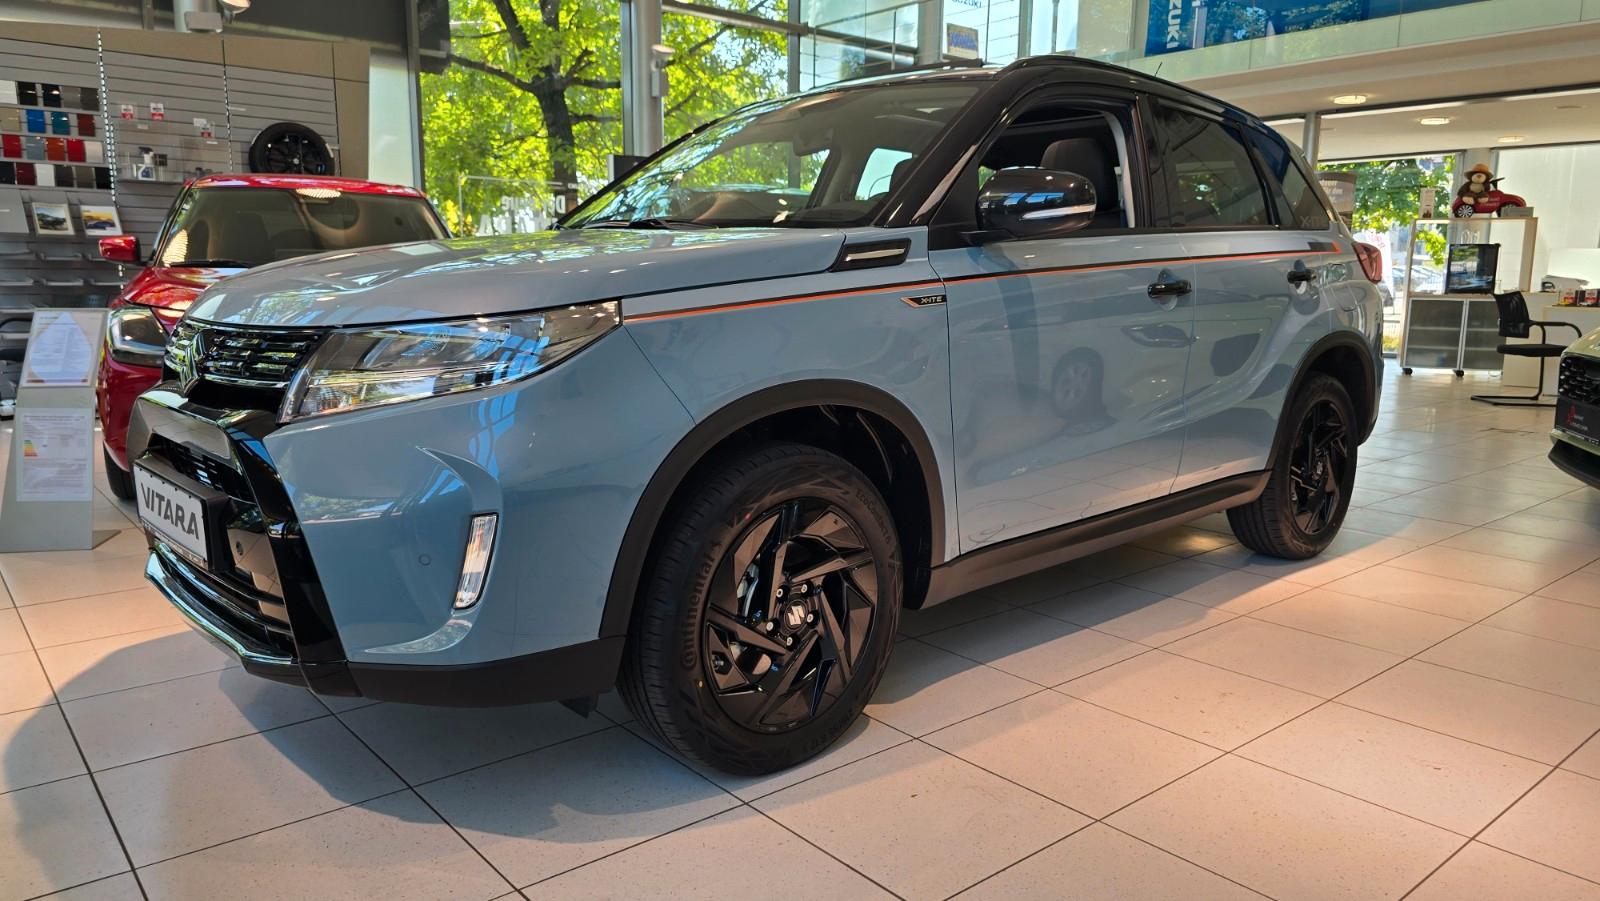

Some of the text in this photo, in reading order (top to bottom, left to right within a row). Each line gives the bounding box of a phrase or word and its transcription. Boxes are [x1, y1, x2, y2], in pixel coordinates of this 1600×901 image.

[952, 0, 982, 8] ZUKI
[920, 296, 942, 304] X-ITE
[141, 482, 199, 540] VITARA
[681, 552, 715, 671] Continental
